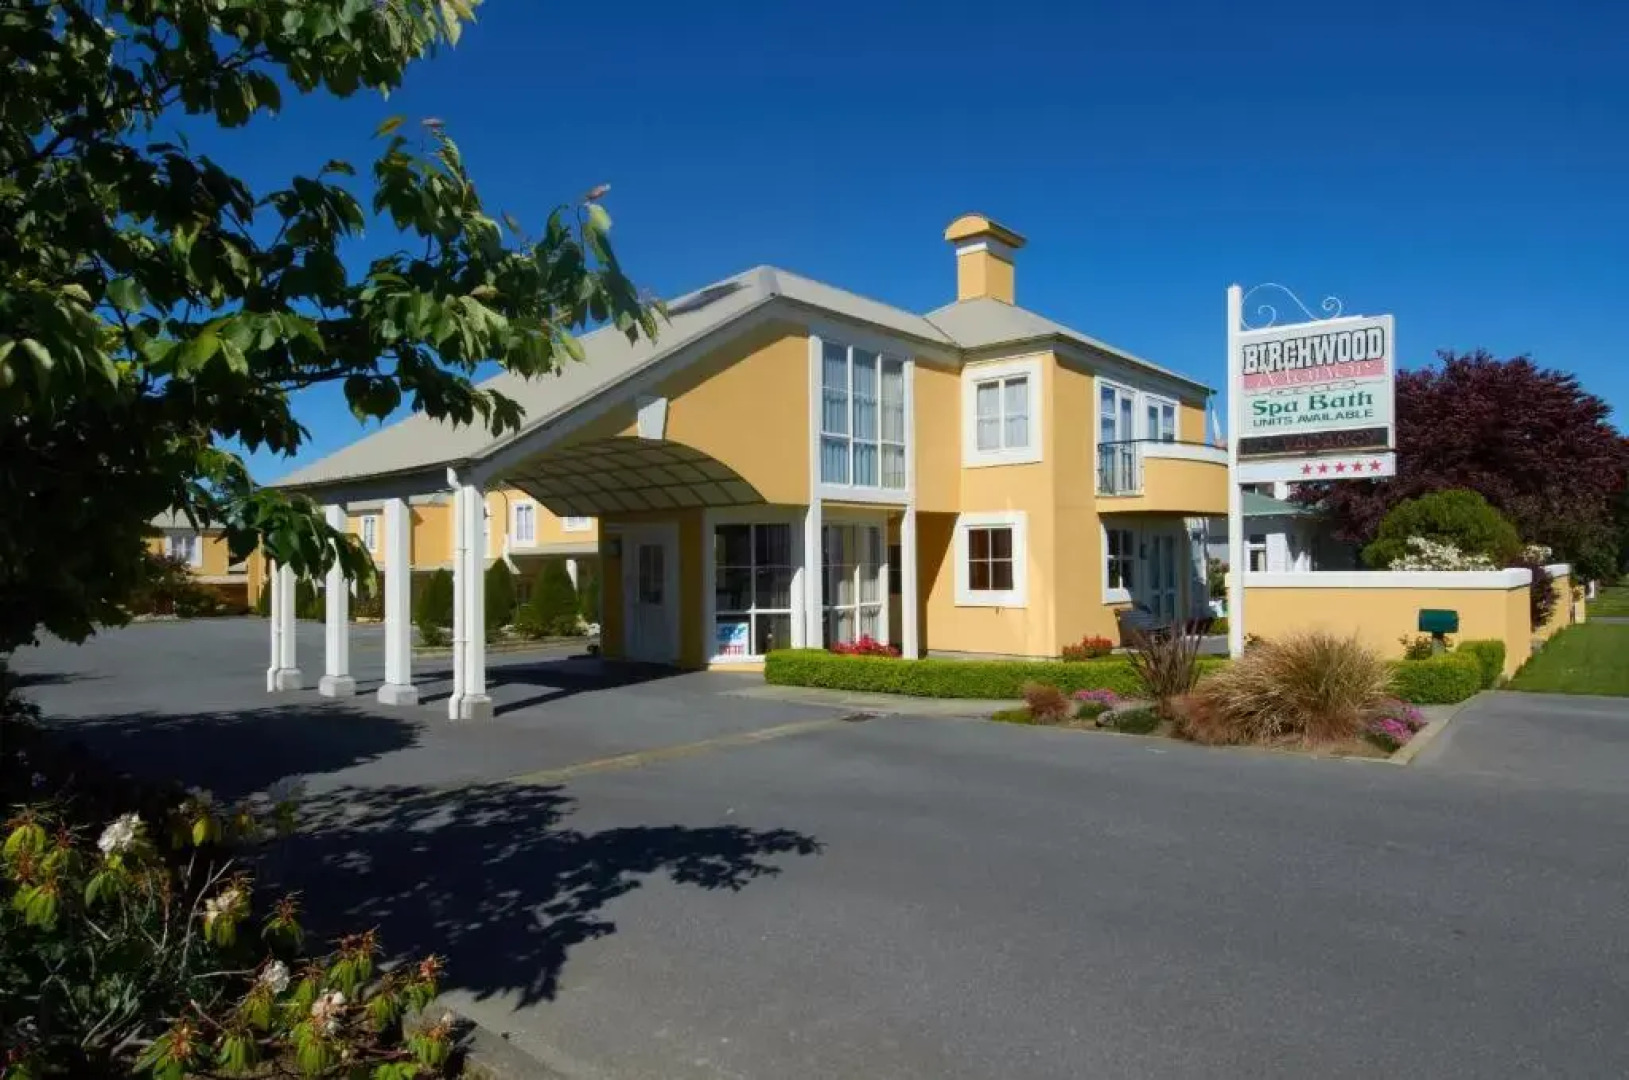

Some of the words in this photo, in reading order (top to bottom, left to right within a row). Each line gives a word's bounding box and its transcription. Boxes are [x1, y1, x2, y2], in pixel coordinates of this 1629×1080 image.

[1243, 326, 1384, 375] BIRCHWOOD
[1252, 400, 1298, 416] Spa
[1308, 391, 1373, 410] Bath
[1253, 416, 1293, 427] UNITS
[1297, 409, 1374, 423] AVAILABLE
